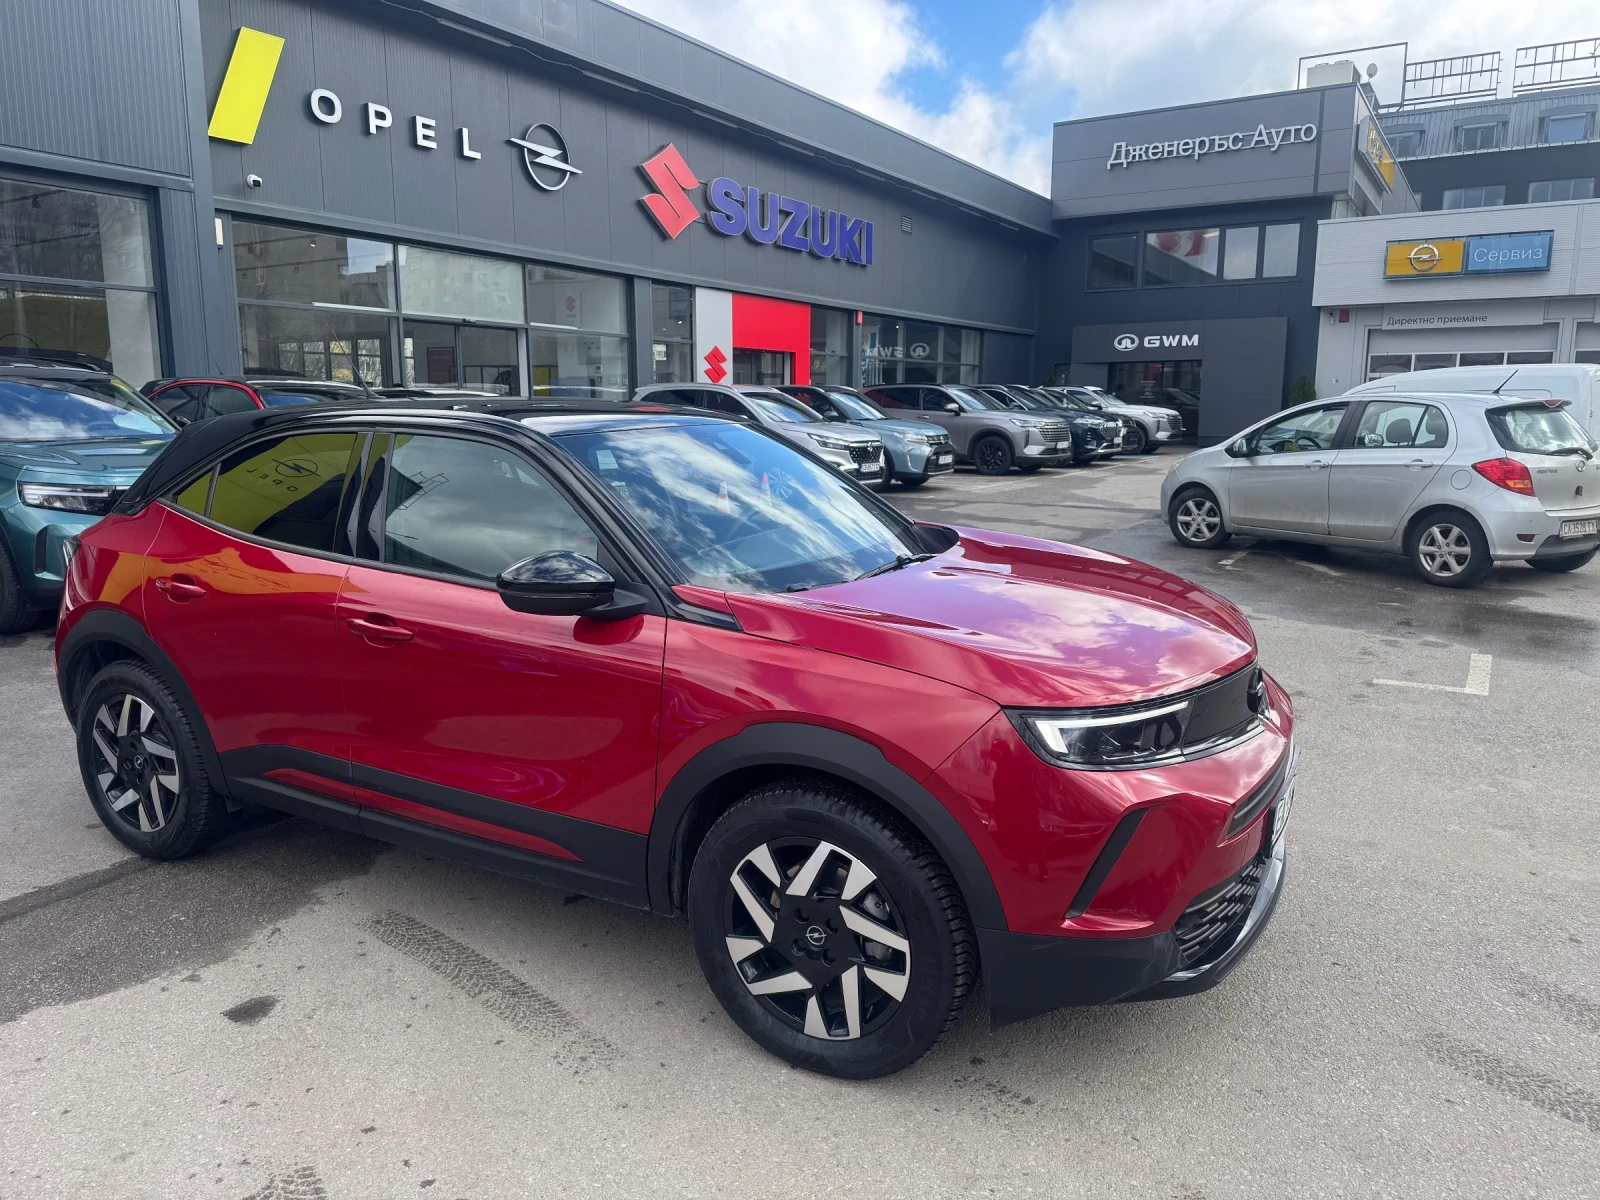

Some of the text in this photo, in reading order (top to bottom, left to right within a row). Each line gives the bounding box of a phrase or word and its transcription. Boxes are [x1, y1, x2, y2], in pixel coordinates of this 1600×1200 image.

[310, 88, 482, 160] OPEL
[1106, 123, 1317, 170] Дженеръс Ауто
[708, 177, 873, 266] SUZUKI
[1473, 247, 1543, 264] Сервиз
[1386, 314, 1488, 327] Директно приемане
[1143, 334, 1199, 348] GWM
